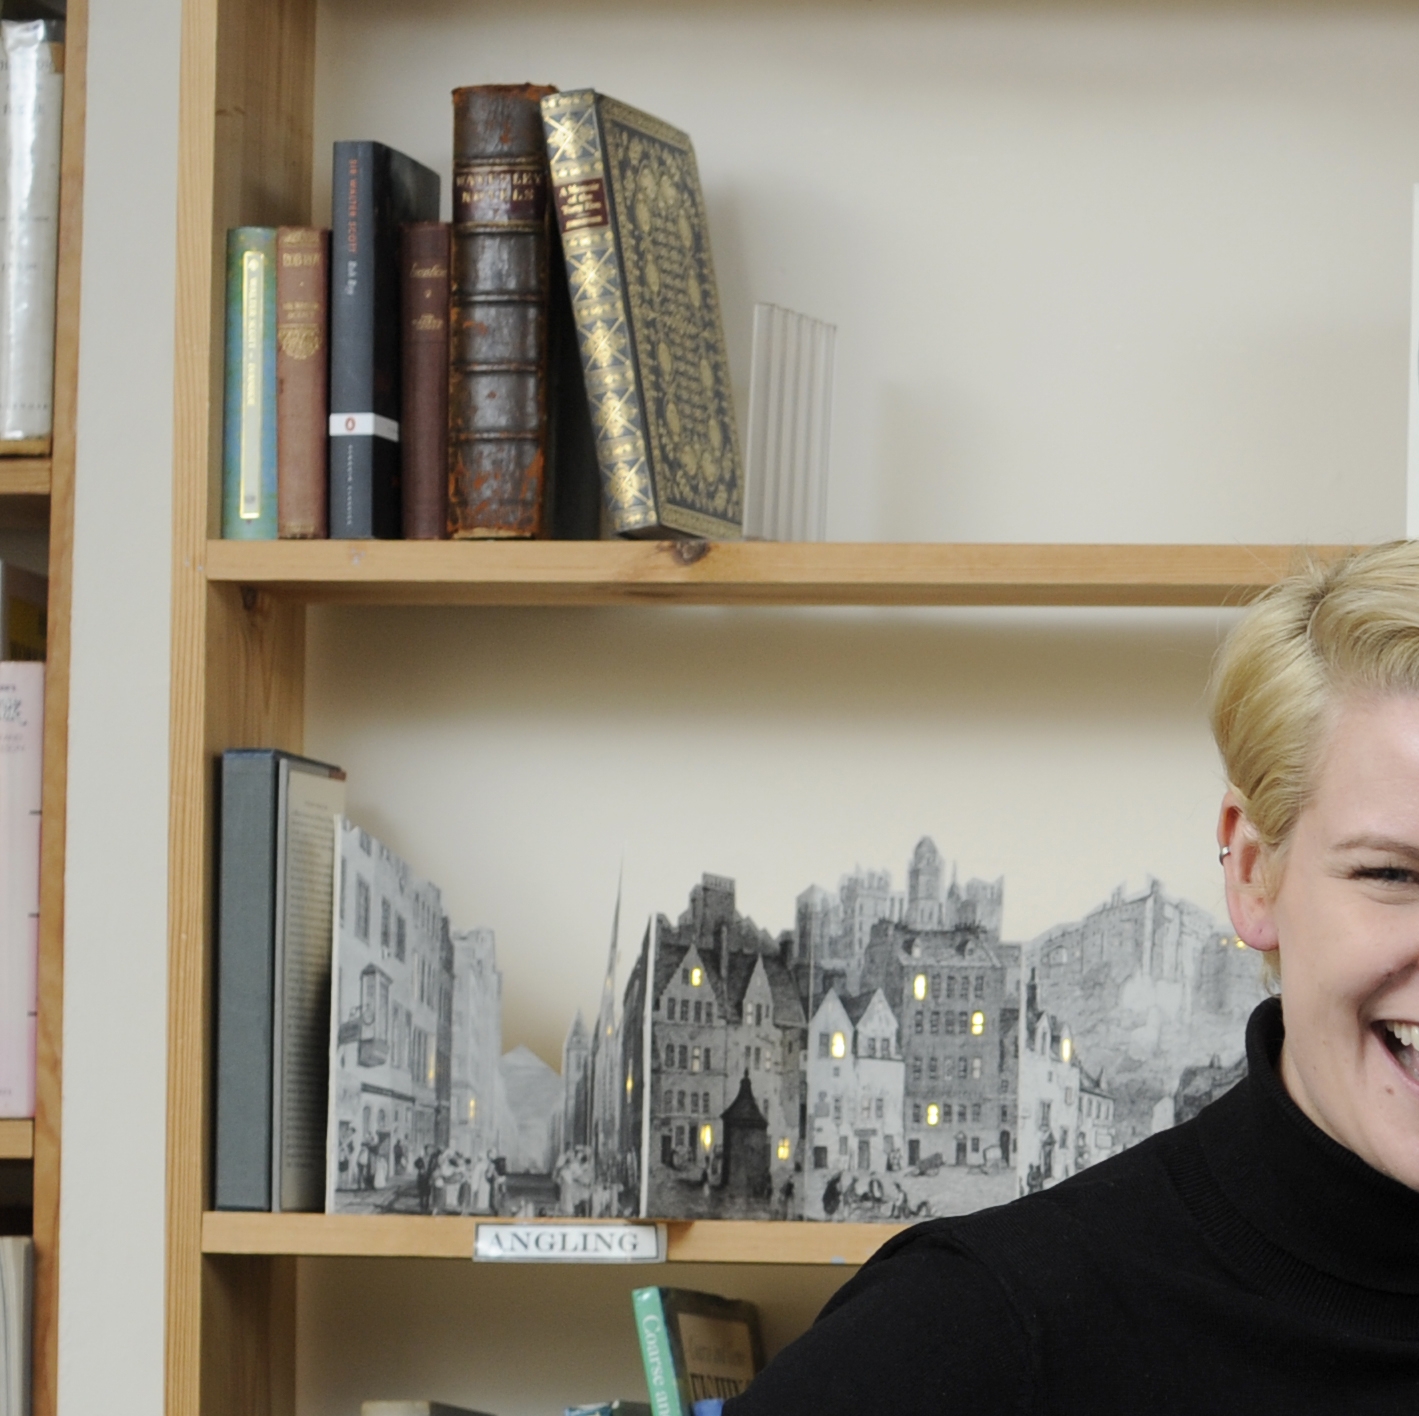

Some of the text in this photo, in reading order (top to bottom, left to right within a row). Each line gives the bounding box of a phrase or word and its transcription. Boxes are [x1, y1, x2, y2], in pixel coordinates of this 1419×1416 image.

[348, 158, 358, 175] SIR
[348, 178, 358, 217] WALTER
[347, 221, 358, 254] SCOTT
[489, 1230, 640, 1253] ANGLING
[636, 1312, 674, 1388] Coarse
